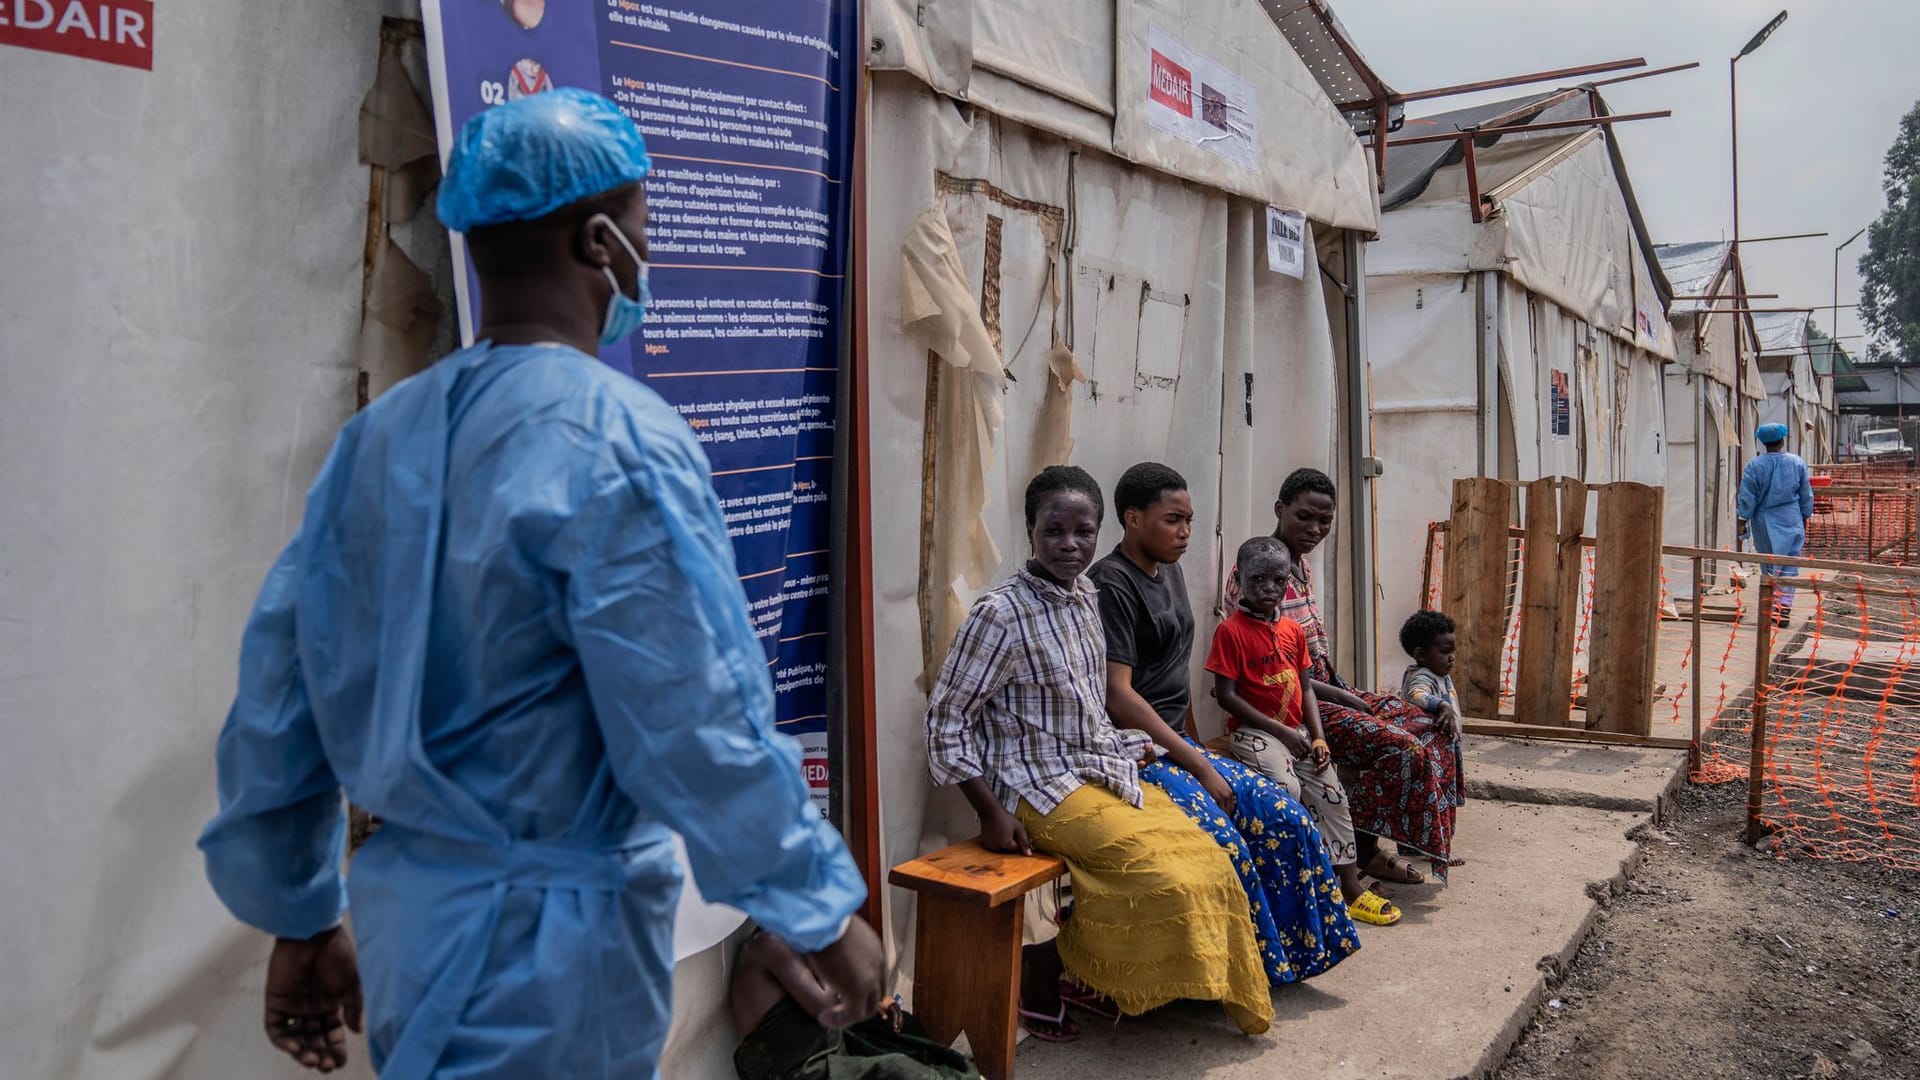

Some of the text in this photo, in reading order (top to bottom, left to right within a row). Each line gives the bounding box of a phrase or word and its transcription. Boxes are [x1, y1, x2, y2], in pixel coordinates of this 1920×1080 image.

[609, 11, 671, 32] elle est évitable.
[641, 5, 653, 14] est
[654, 7, 668, 18] une
[670, 11, 698, 23] maladie
[699, 15, 740, 32] dangereuse
[766, 30, 777, 39] par
[778, 31, 785, 40] le
[786, 32, 802, 43] virus
[1153, 62, 1190, 105] MEDAIR
[480, 80, 506, 106] 02
[612, 75, 623, 86] Le
[624, 77, 645, 90] Mpox
[646, 82, 655, 91] se
[656, 83, 691, 97] transmet
[691, 88, 745, 105] principalement
[746, 98, 757, 107] par
[758, 99, 784, 110] contact
[630, 92, 661, 106] l'animal
[662, 98, 689, 110] malade
[690, 103, 707, 113] avec
[708, 106, 718, 114] ou
[719, 107, 735, 116] sans
[736, 107, 759, 120] signes
[772, 115, 802, 126] personne
[632, 107, 641, 118] la
[641, 111, 676, 123] personne
[677, 115, 704, 126] malade
[711, 118, 718, 128] la
[719, 121, 752, 132] personne
[753, 126, 766, 134] non
[767, 126, 792, 137] malade
[671, 127, 710, 141] également
[711, 132, 720, 142] de
[721, 133, 730, 143] la
[730, 135, 747, 146] mère
[749, 137, 774, 148] malade
[780, 140, 804, 152] l'enfant
[657, 169, 666, 178] se
[667, 169, 704, 181] manifeste
[705, 172, 722, 183] chez
[723, 173, 734, 184] les
[734, 174, 764, 186] humains
[645, 180, 665, 192] forte
[689, 185, 732, 198] d'apparition
[733, 188, 758, 200] brutale
[684, 200, 718, 211] cutanées
[718, 203, 735, 212] avec
[787, 207, 797, 216] de
[658, 213, 671, 224] par
[672, 215, 681, 223] se
[682, 213, 719, 225] dessécher
[720, 217, 730, 225] et
[729, 216, 753, 227] former
[754, 218, 766, 228] des
[657, 226, 672, 237] des
[672, 229, 702, 239] paumes
[703, 229, 717, 239] des
[717, 229, 739, 240] mains
[740, 232, 749, 241] et
[748, 231, 760, 241] les
[760, 232, 785, 244] plantes
[785, 234, 797, 243] des
[686, 245, 698, 253] sur
[699, 244, 717, 254] tout
[716, 244, 725, 254] le
[655, 300, 694, 310] personnes
[695, 297, 708, 310] qui
[709, 299, 735, 308] entrent
[736, 300, 746, 308] en
[746, 299, 772, 308] contact
[772, 298, 791, 309] direct
[663, 312, 696, 323] animaux
[728, 313, 739, 322] les
[740, 312, 774, 324] chasseurs,
[643, 329, 664, 338] teurs
[665, 328, 679, 338] des
[680, 327, 714, 339] animaux,
[715, 327, 726, 337] les
[645, 344, 669, 355] Mpox.
[679, 404, 697, 413] tout
[696, 402, 724, 412] contact
[725, 399, 756, 413] physique
[757, 400, 766, 408] et
[710, 418, 720, 426] ou
[721, 416, 740, 425] toute
[741, 415, 759, 424] autre
[727, 498, 743, 507] avec
[743, 496, 757, 505] une
[757, 493, 785, 506] personne
[752, 509, 764, 518] les
[763, 505, 781, 517] mains
[745, 524, 754, 534] de
